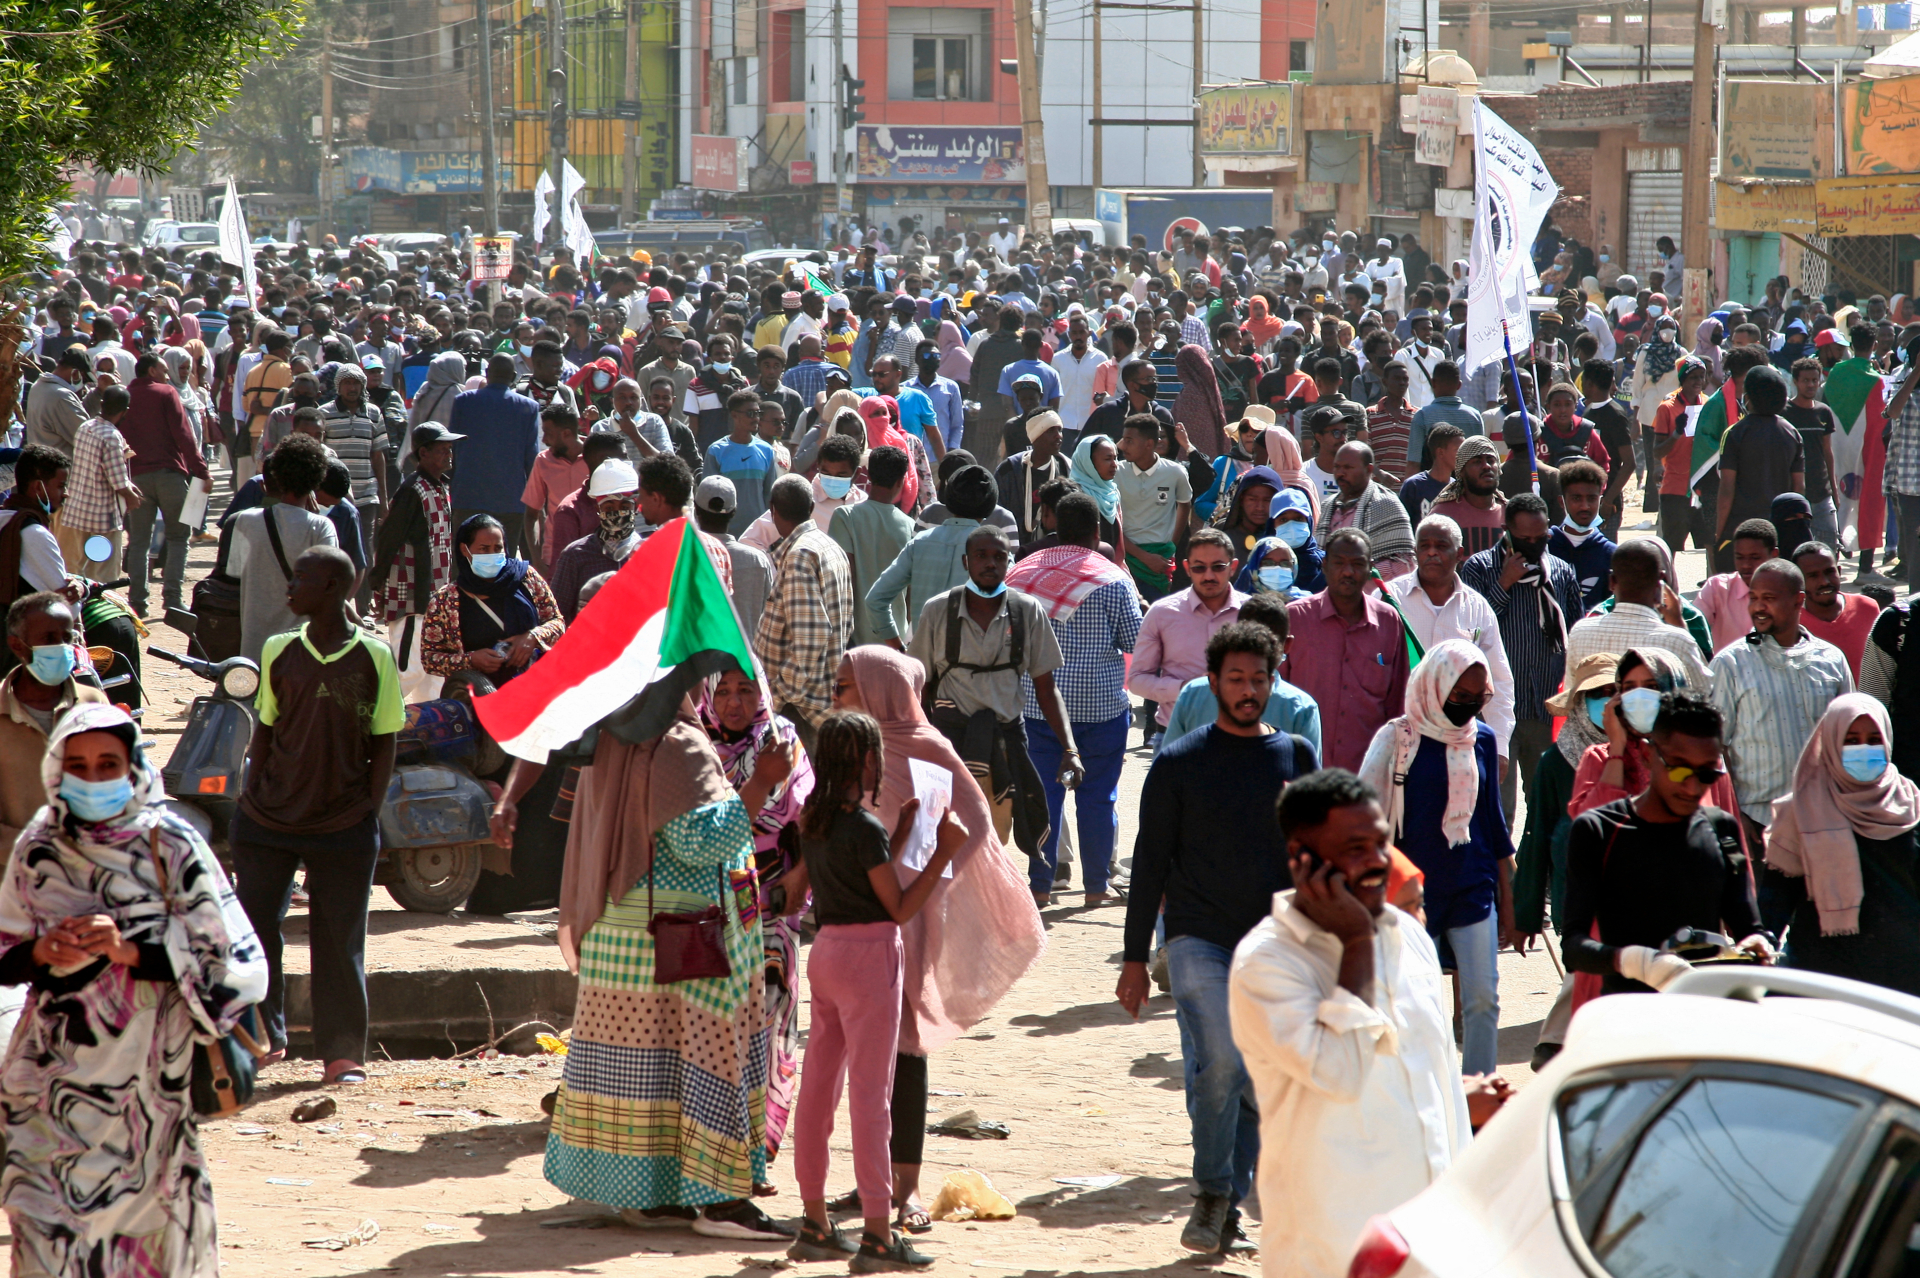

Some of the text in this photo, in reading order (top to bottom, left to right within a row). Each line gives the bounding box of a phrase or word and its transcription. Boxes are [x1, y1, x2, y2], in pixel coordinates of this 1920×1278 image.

[1881, 118, 1920, 133] المدرسية
[888, 133, 1000, 165] الوليد سنتر
[448, 153, 483, 172] اركت
